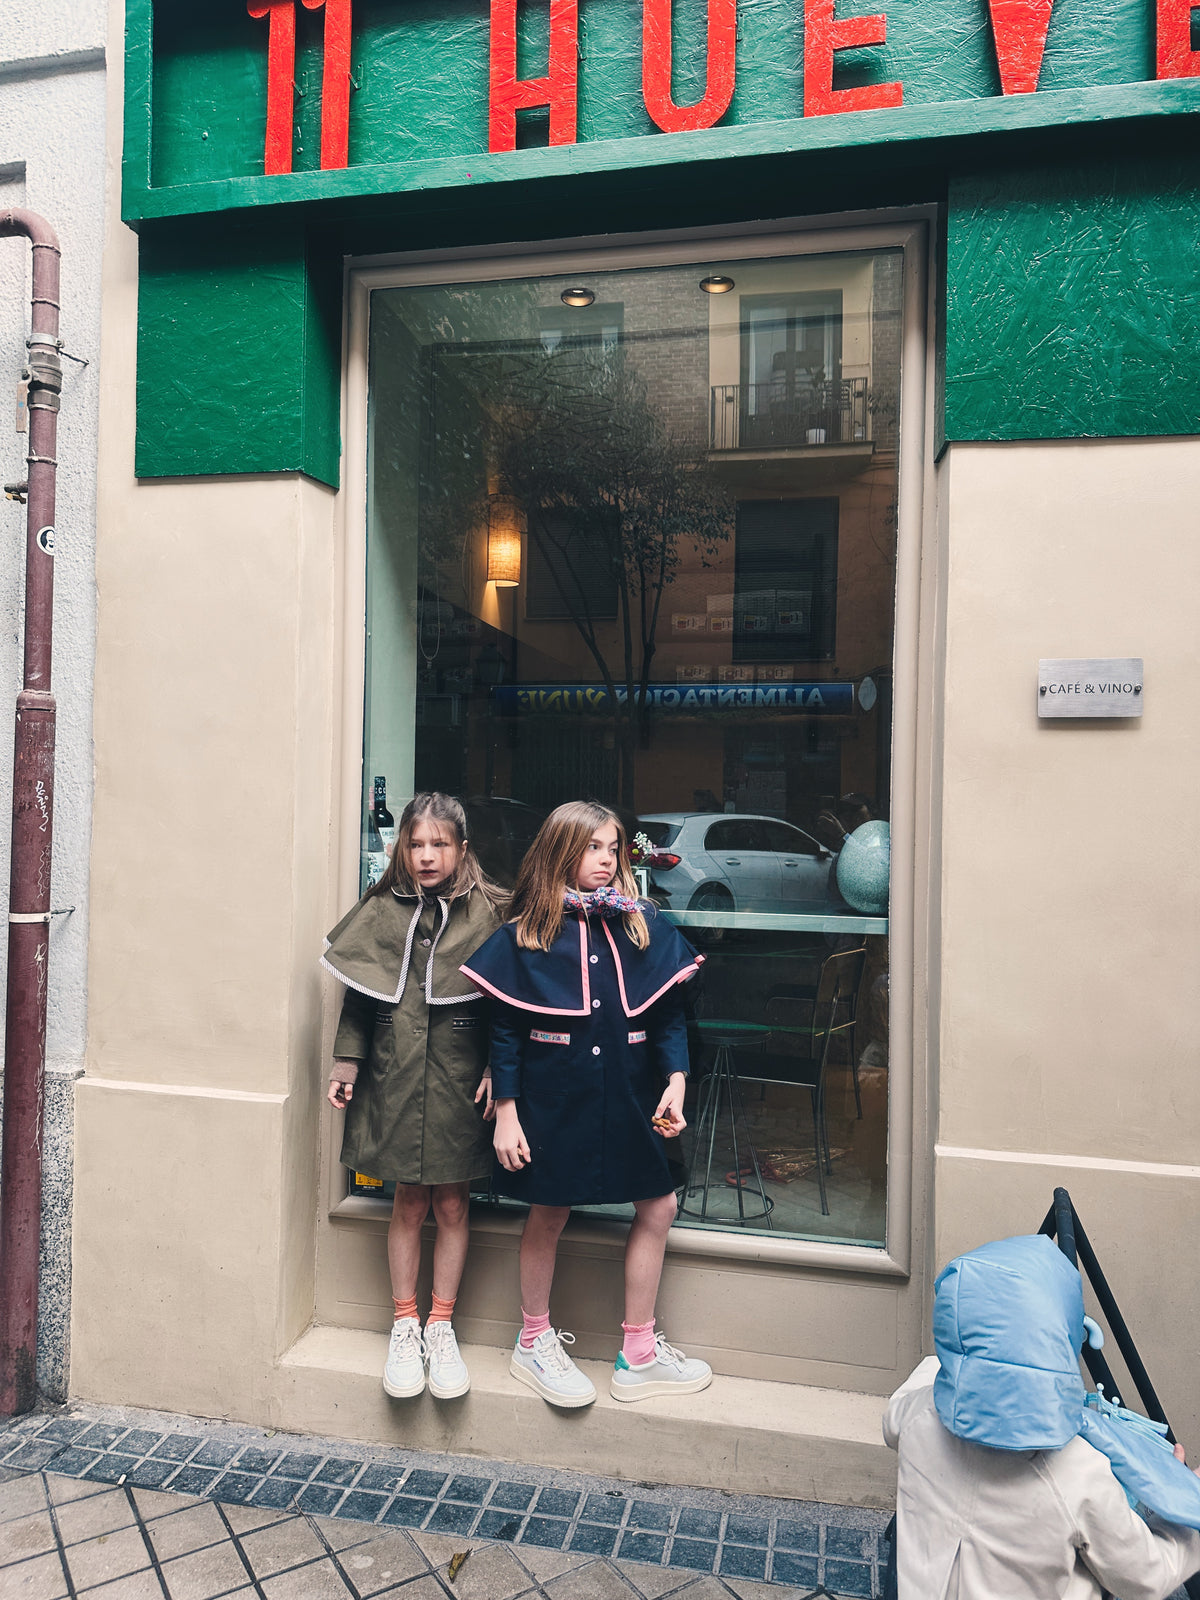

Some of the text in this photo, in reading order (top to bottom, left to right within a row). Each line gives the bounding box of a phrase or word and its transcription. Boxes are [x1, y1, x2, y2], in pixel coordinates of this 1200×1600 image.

[487, 0, 1200, 153] HUEV
[1048, 681, 1133, 694] CAFÉ & VINO
